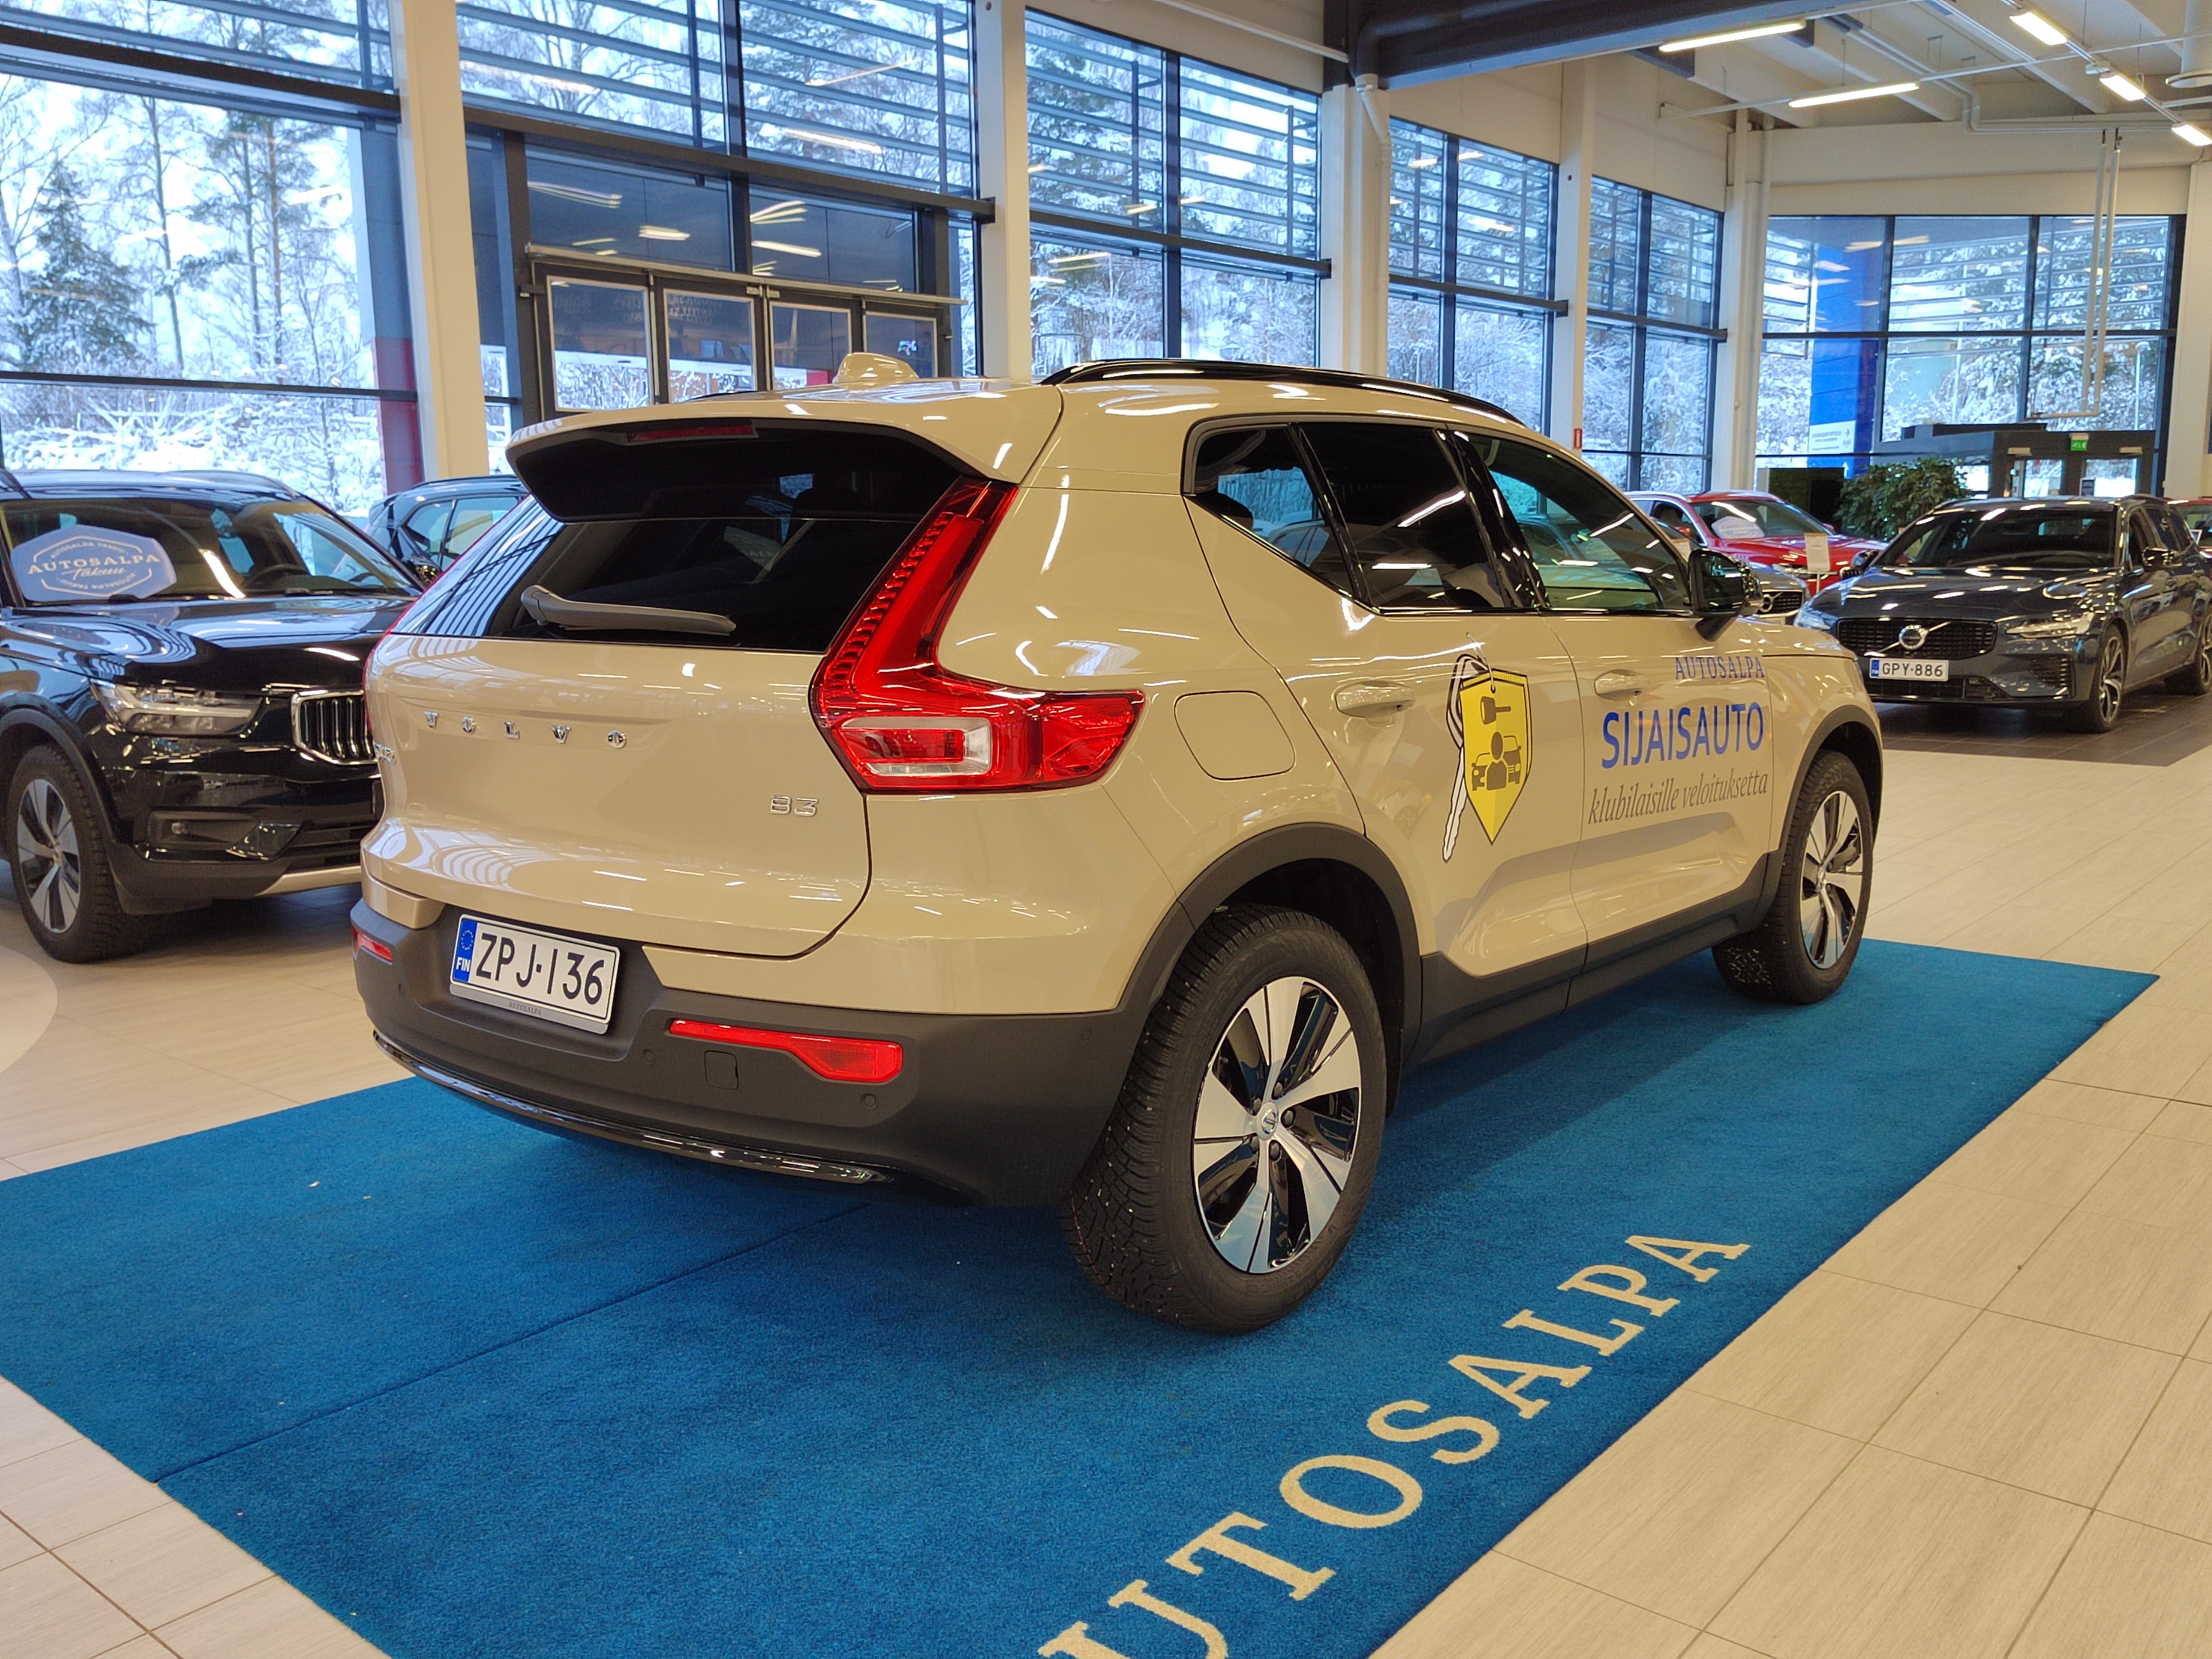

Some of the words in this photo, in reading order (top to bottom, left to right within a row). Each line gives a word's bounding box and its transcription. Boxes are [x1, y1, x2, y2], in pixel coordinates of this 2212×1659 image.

[28, 554, 160, 575] AUTOSALPA
[1674, 656, 1765, 679] AUTOSALPA
[1882, 662, 1943, 677] GPY-886
[423, 711, 626, 749] VOLVO
[1601, 702, 1764, 769] SIJAISAUTO
[770, 796, 818, 816] B3
[1588, 777, 1679, 825] klubilaisille
[1682, 767, 1768, 809] veloituksetta
[456, 956, 471, 972] FIN
[476, 933, 605, 1005] ZPJ-136
[508, 1001, 542, 1016] AUTOSALPA
